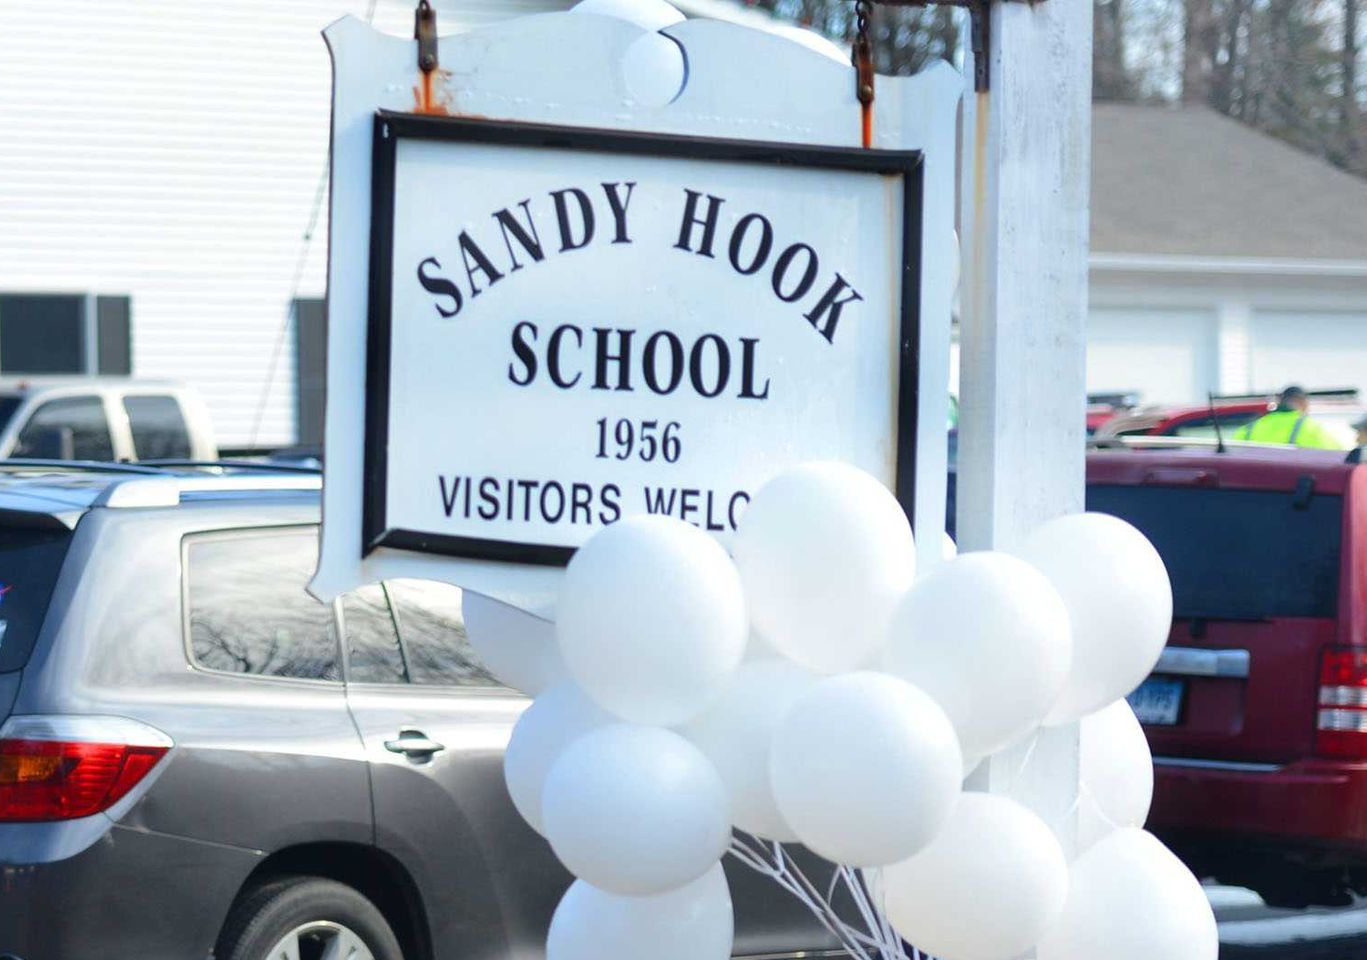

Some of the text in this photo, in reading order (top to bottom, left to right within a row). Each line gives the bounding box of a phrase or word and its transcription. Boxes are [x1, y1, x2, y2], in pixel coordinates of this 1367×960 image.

[416, 182, 864, 344] SANDY HOOK
[508, 321, 770, 400] SCHOOL
[595, 417, 682, 463] 1956
[438, 475, 621, 526] VISITORS
